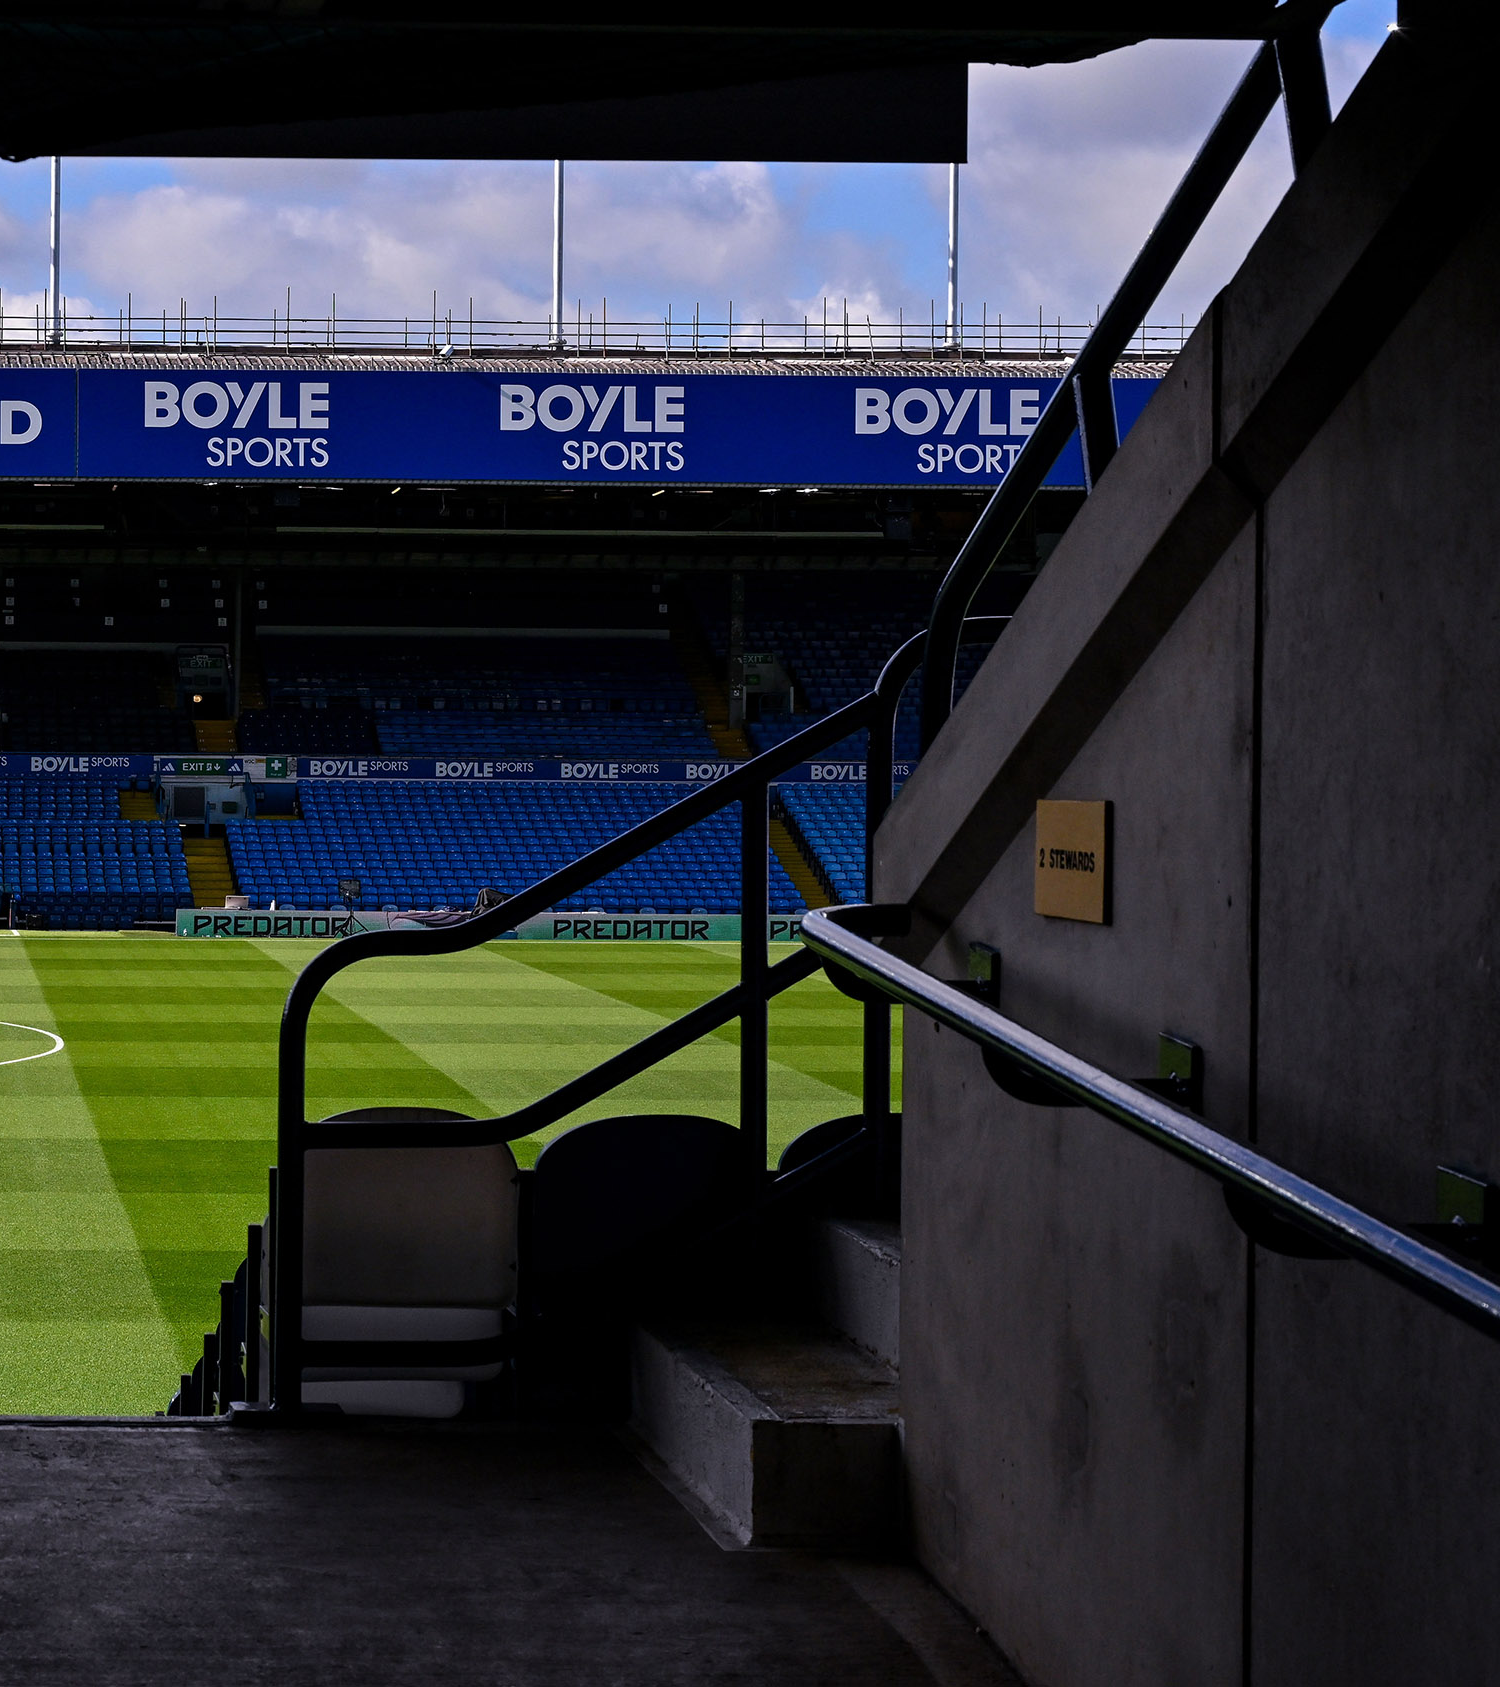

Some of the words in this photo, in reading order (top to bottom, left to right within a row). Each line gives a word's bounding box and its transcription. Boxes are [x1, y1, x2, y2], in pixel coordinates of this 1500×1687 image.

[144, 381, 329, 428] BOYLE
[499, 385, 684, 432] BOYLE
[855, 388, 1039, 435] BOYLE
[206, 437, 329, 467] SPORTS
[562, 441, 684, 471] SPORTS
[917, 444, 1020, 473] SPORT
[31, 757, 88, 772] BOYLE
[91, 757, 129, 767] SPORTS
[182, 762, 204, 771] EXIT
[310, 760, 367, 776] BOYLE
[370, 761, 408, 771] SPORTS
[435, 762, 492, 777] BOYLE
[495, 762, 533, 772] SPORTS
[561, 763, 618, 778] BOYLE
[621, 763, 659, 774] SPORTS
[811, 765, 867, 780] BOYLE
[1040, 848, 1045, 867] 2
[1050, 849, 1095, 873] STEWARDS
[194, 915, 348, 936] PREDATOR
[553, 919, 709, 940] PREDATOR
